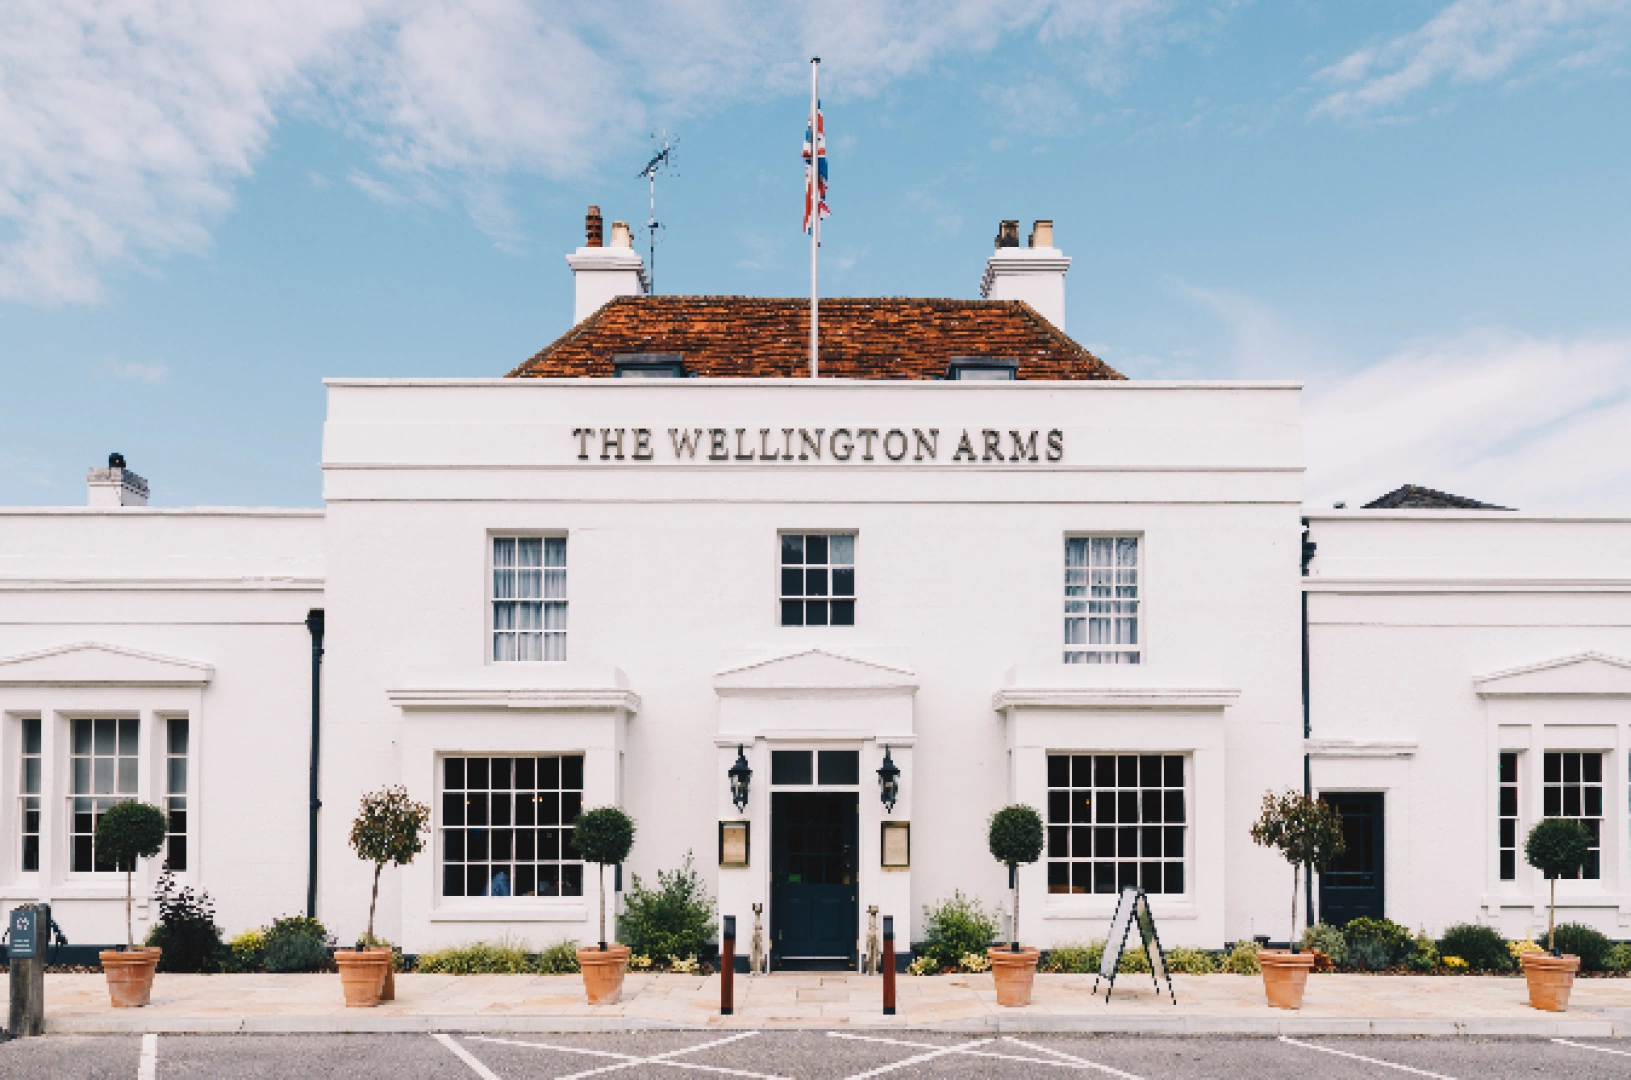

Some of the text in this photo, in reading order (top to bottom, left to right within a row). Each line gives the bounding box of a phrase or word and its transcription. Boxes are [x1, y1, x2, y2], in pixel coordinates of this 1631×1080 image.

[571, 427, 1065, 462] THE WELLINGTON ARMS
